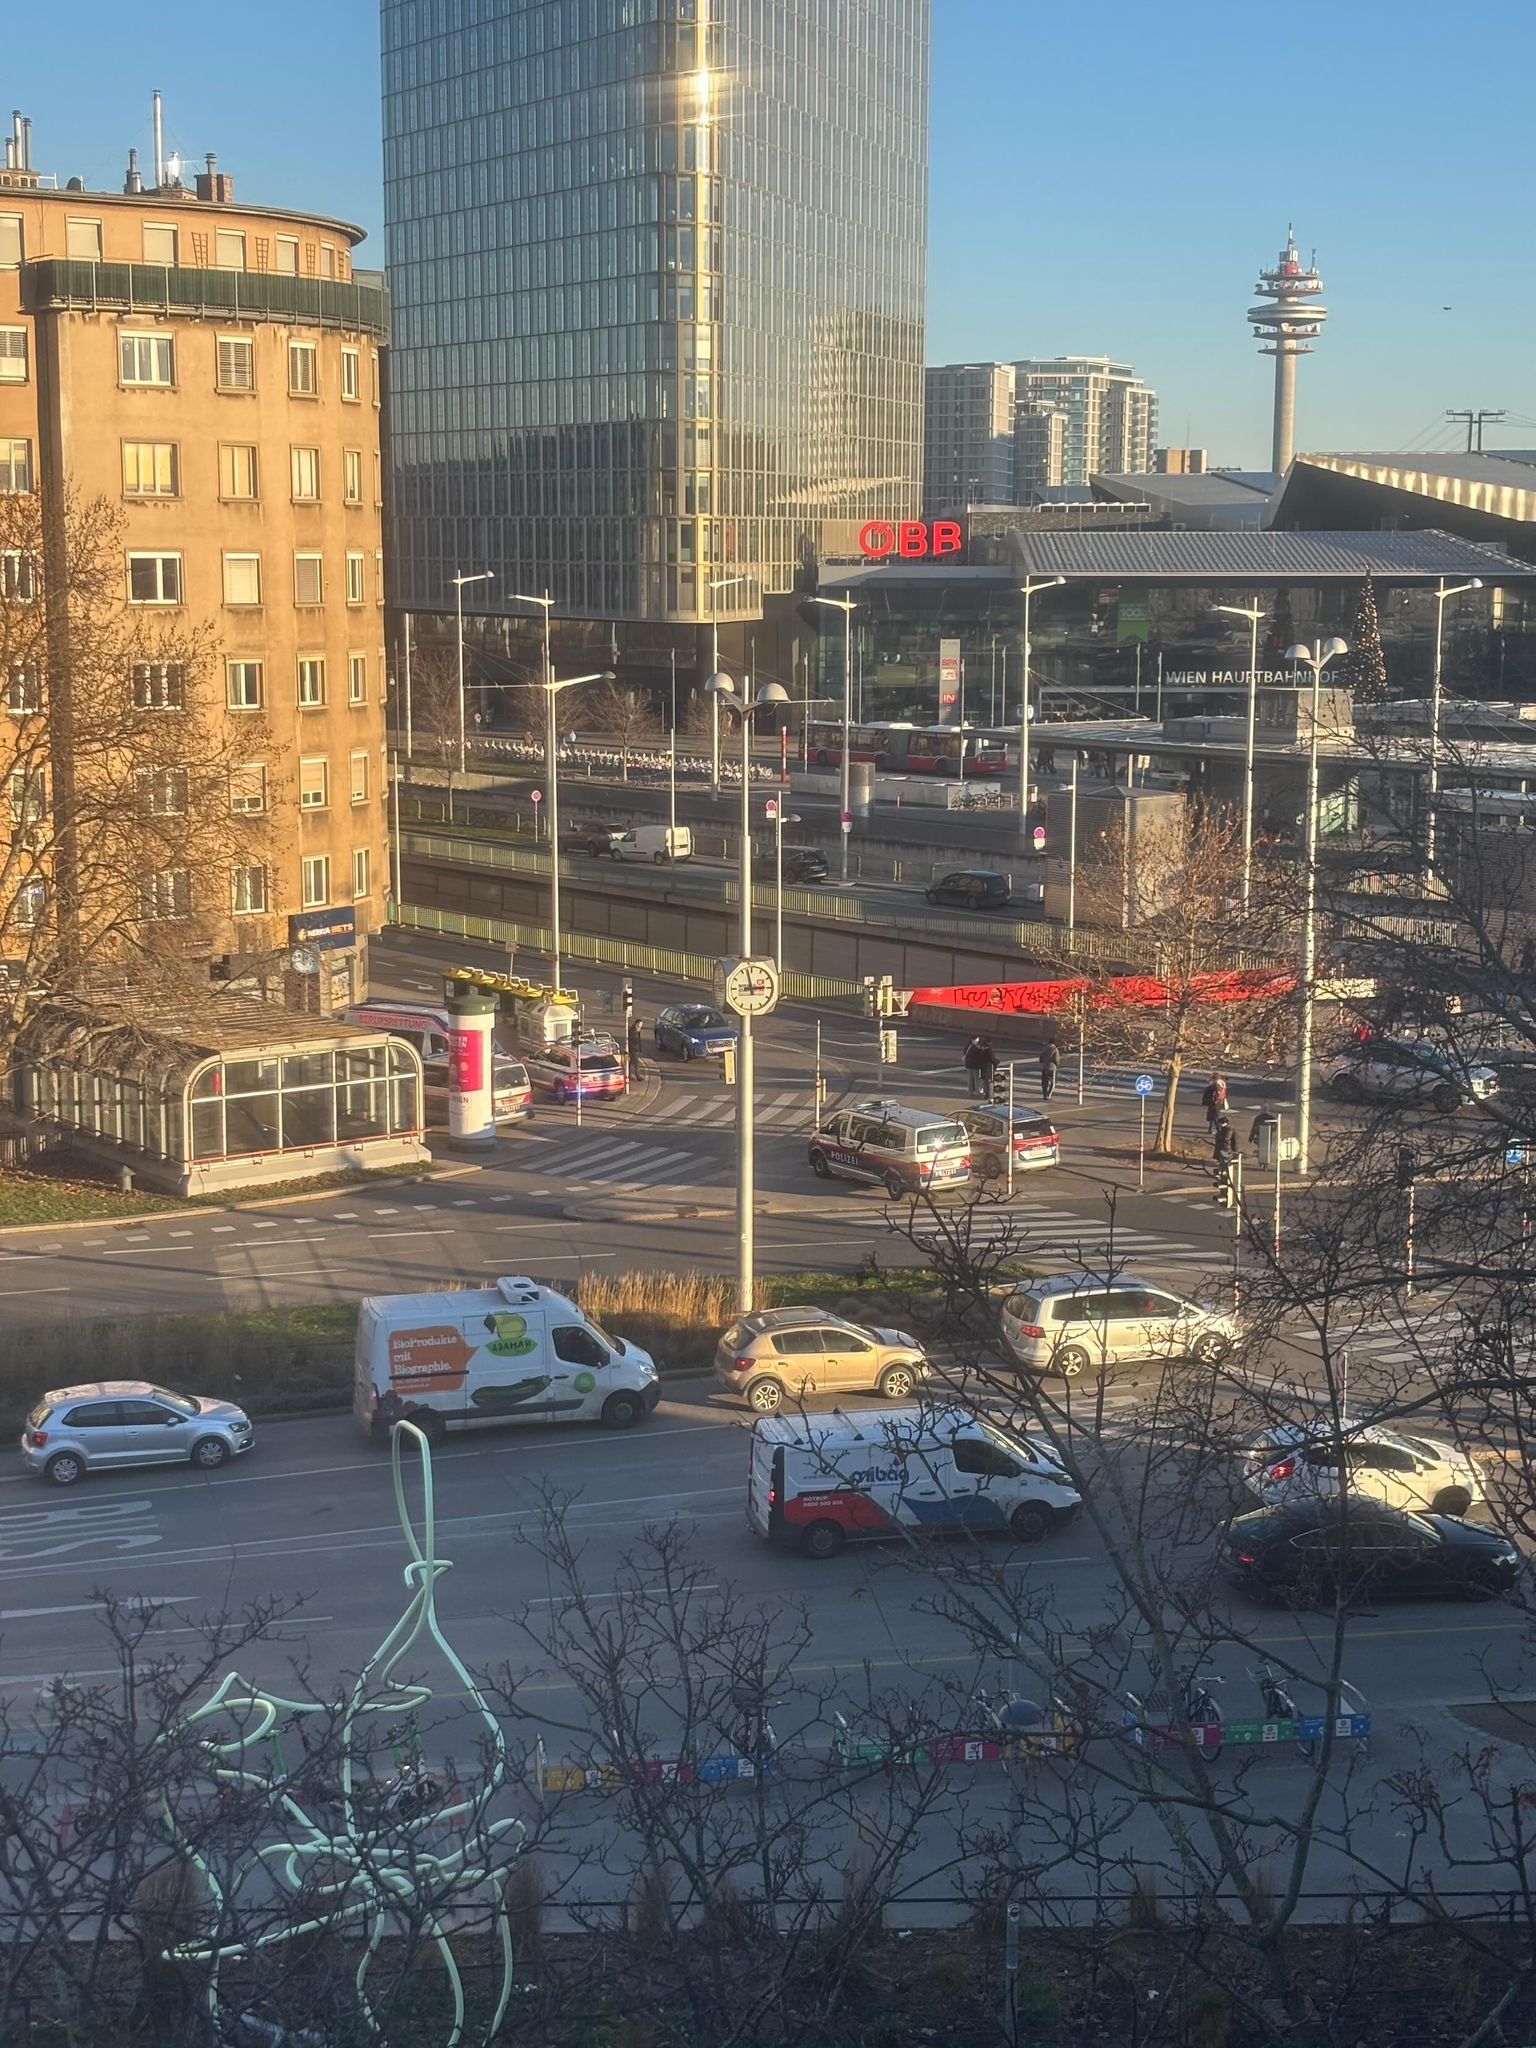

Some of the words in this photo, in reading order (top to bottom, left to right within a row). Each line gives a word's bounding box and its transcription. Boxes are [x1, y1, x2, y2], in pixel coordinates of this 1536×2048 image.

[859, 521, 962, 558] ÖBB
[1166, 671, 1206, 684] WIEN
[331, 923, 354, 933] BETS
[359, 1015, 427, 1030] BERUFSRETTUNG
[831, 1151, 860, 1166] POLIZEI
[393, 1335, 457, 1349] BioProdukte
[492, 1339, 532, 1352] ADAMAH
[393, 1352, 412, 1362] mit
[393, 1361, 452, 1376] Biographie.
